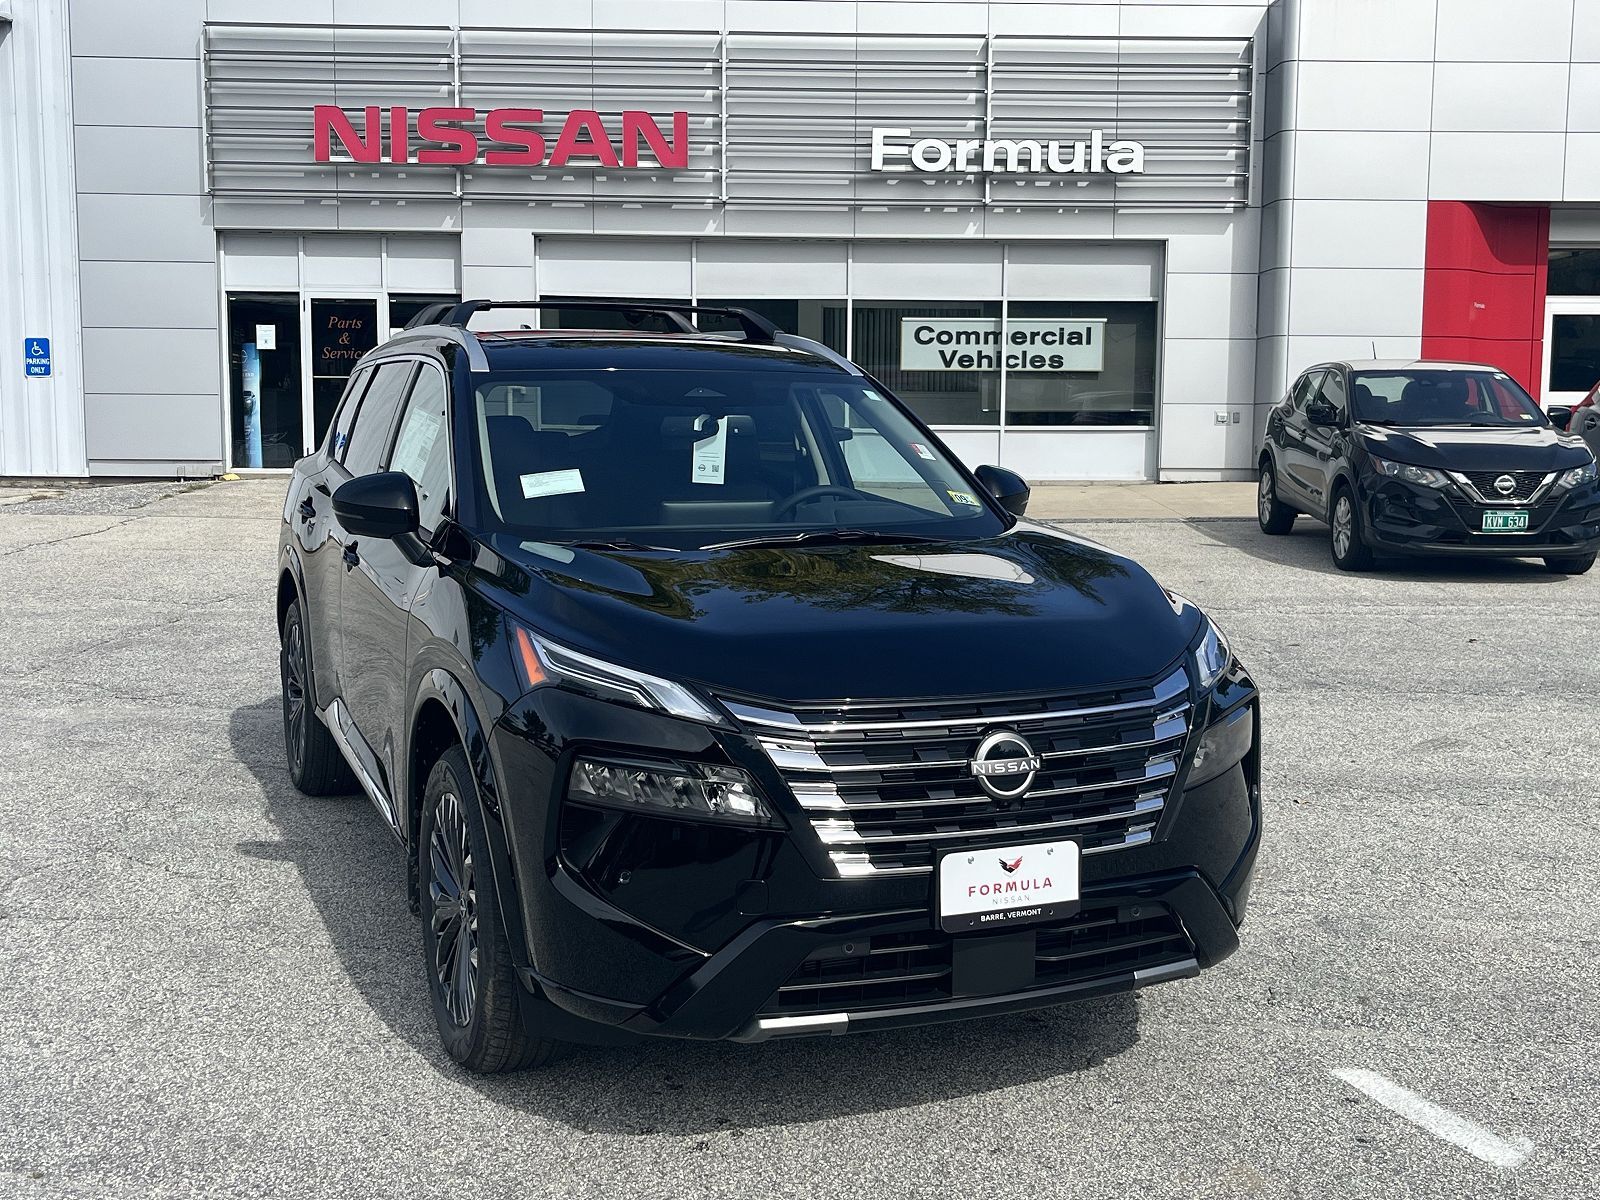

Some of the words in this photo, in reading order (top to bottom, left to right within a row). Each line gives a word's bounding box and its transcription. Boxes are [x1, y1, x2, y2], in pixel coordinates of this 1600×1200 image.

[314, 105, 689, 169] NISSAN
[871, 127, 1145, 174] Formula
[327, 316, 363, 329] Parts
[338, 331, 351, 345] &
[913, 325, 1092, 346] Commercial
[938, 350, 1065, 369] Vehicles
[30, 366, 46, 374] ONLY
[1508, 516, 1524, 527] 634
[973, 758, 1040, 774] NISSAN
[968, 877, 1053, 897] FORMULA
[992, 895, 1031, 905] NISSAN
[980, 912, 1006, 922] BARRE,
[1007, 908, 1042, 919] VERMONT
